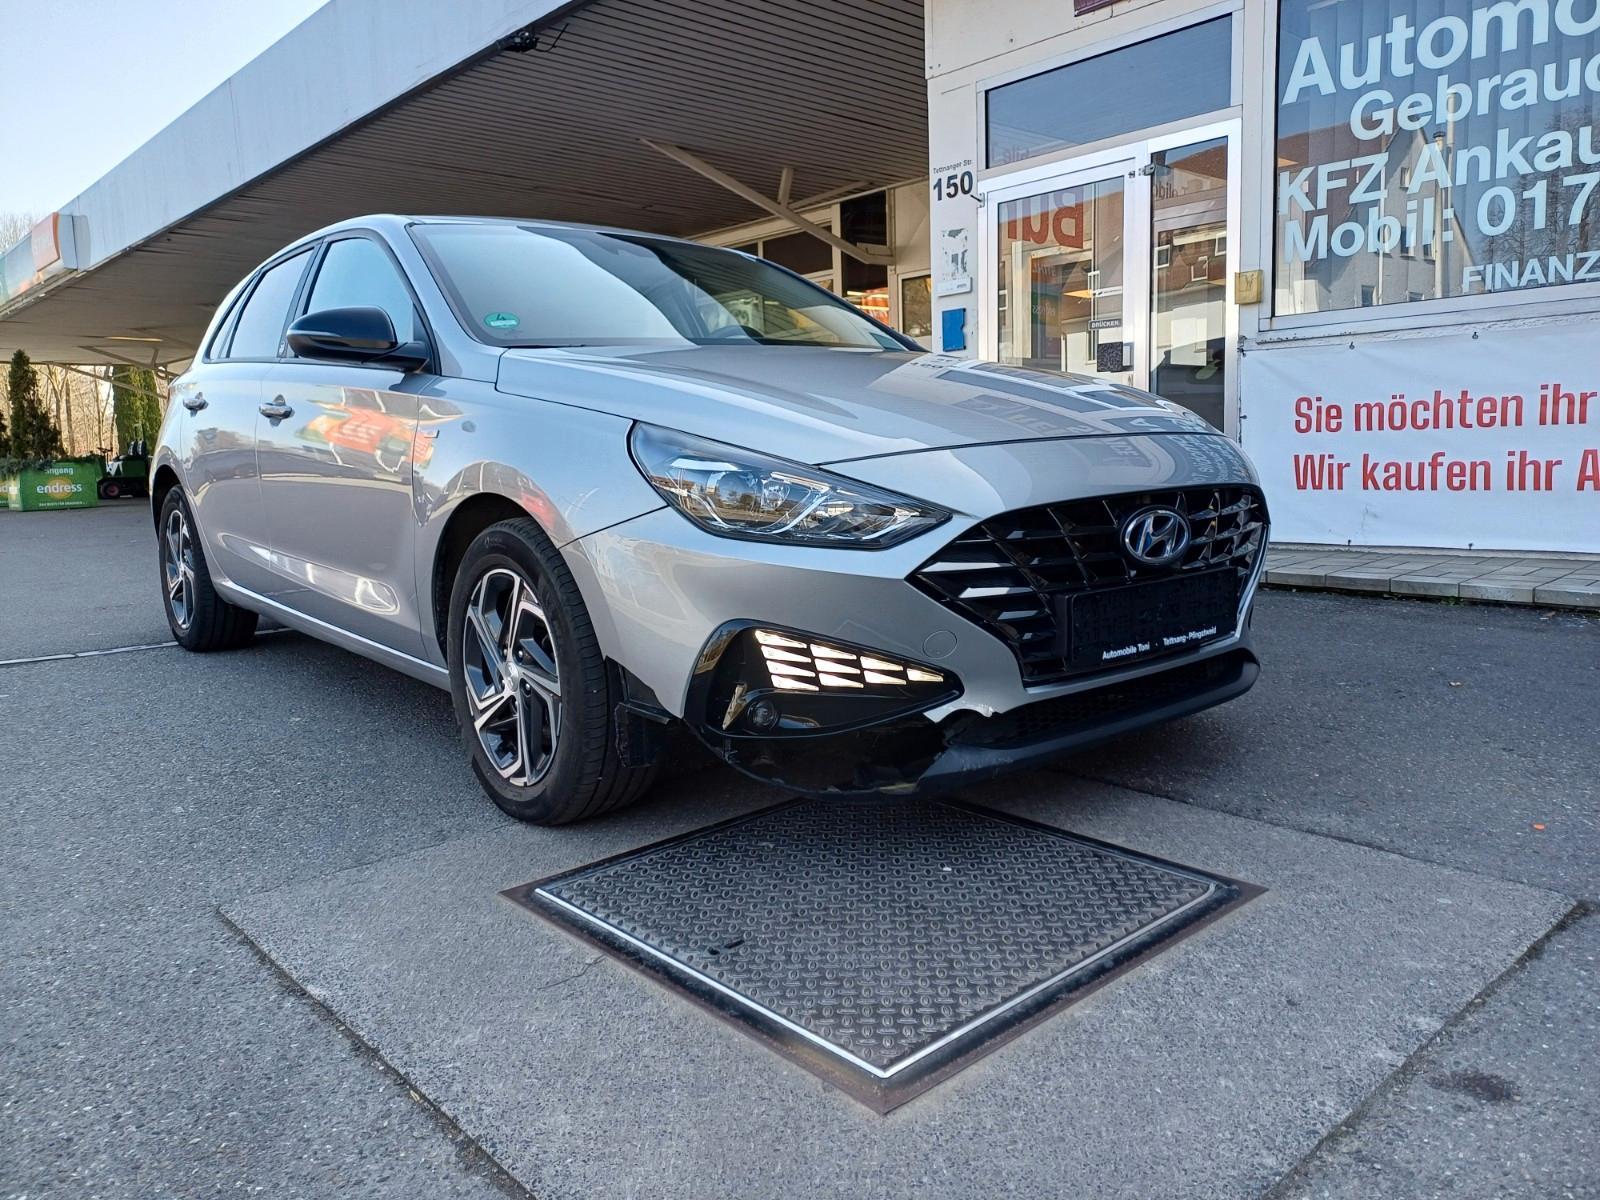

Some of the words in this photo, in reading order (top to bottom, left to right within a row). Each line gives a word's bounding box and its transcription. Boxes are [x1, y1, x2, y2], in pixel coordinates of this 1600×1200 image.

[933, 171, 973, 201] 150
[1279, 152, 1389, 216] KFZ
[1284, 197, 1454, 265] Mobil:
[1477, 172, 1600, 237] 017
[1462, 251, 1600, 293] FINANZ
[1295, 396, 1343, 433] Sie
[1354, 390, 1524, 431] möchten
[1539, 384, 1598, 426] ihr
[36, 483, 82, 494] endress
[1294, 454, 1351, 491] Wir
[1362, 452, 1492, 491] kaufen
[1507, 451, 1563, 491] ihr
[1576, 449, 1600, 491] A
[1102, 646, 1137, 660] Automobile
[1137, 641, 1150, 653] Toni
